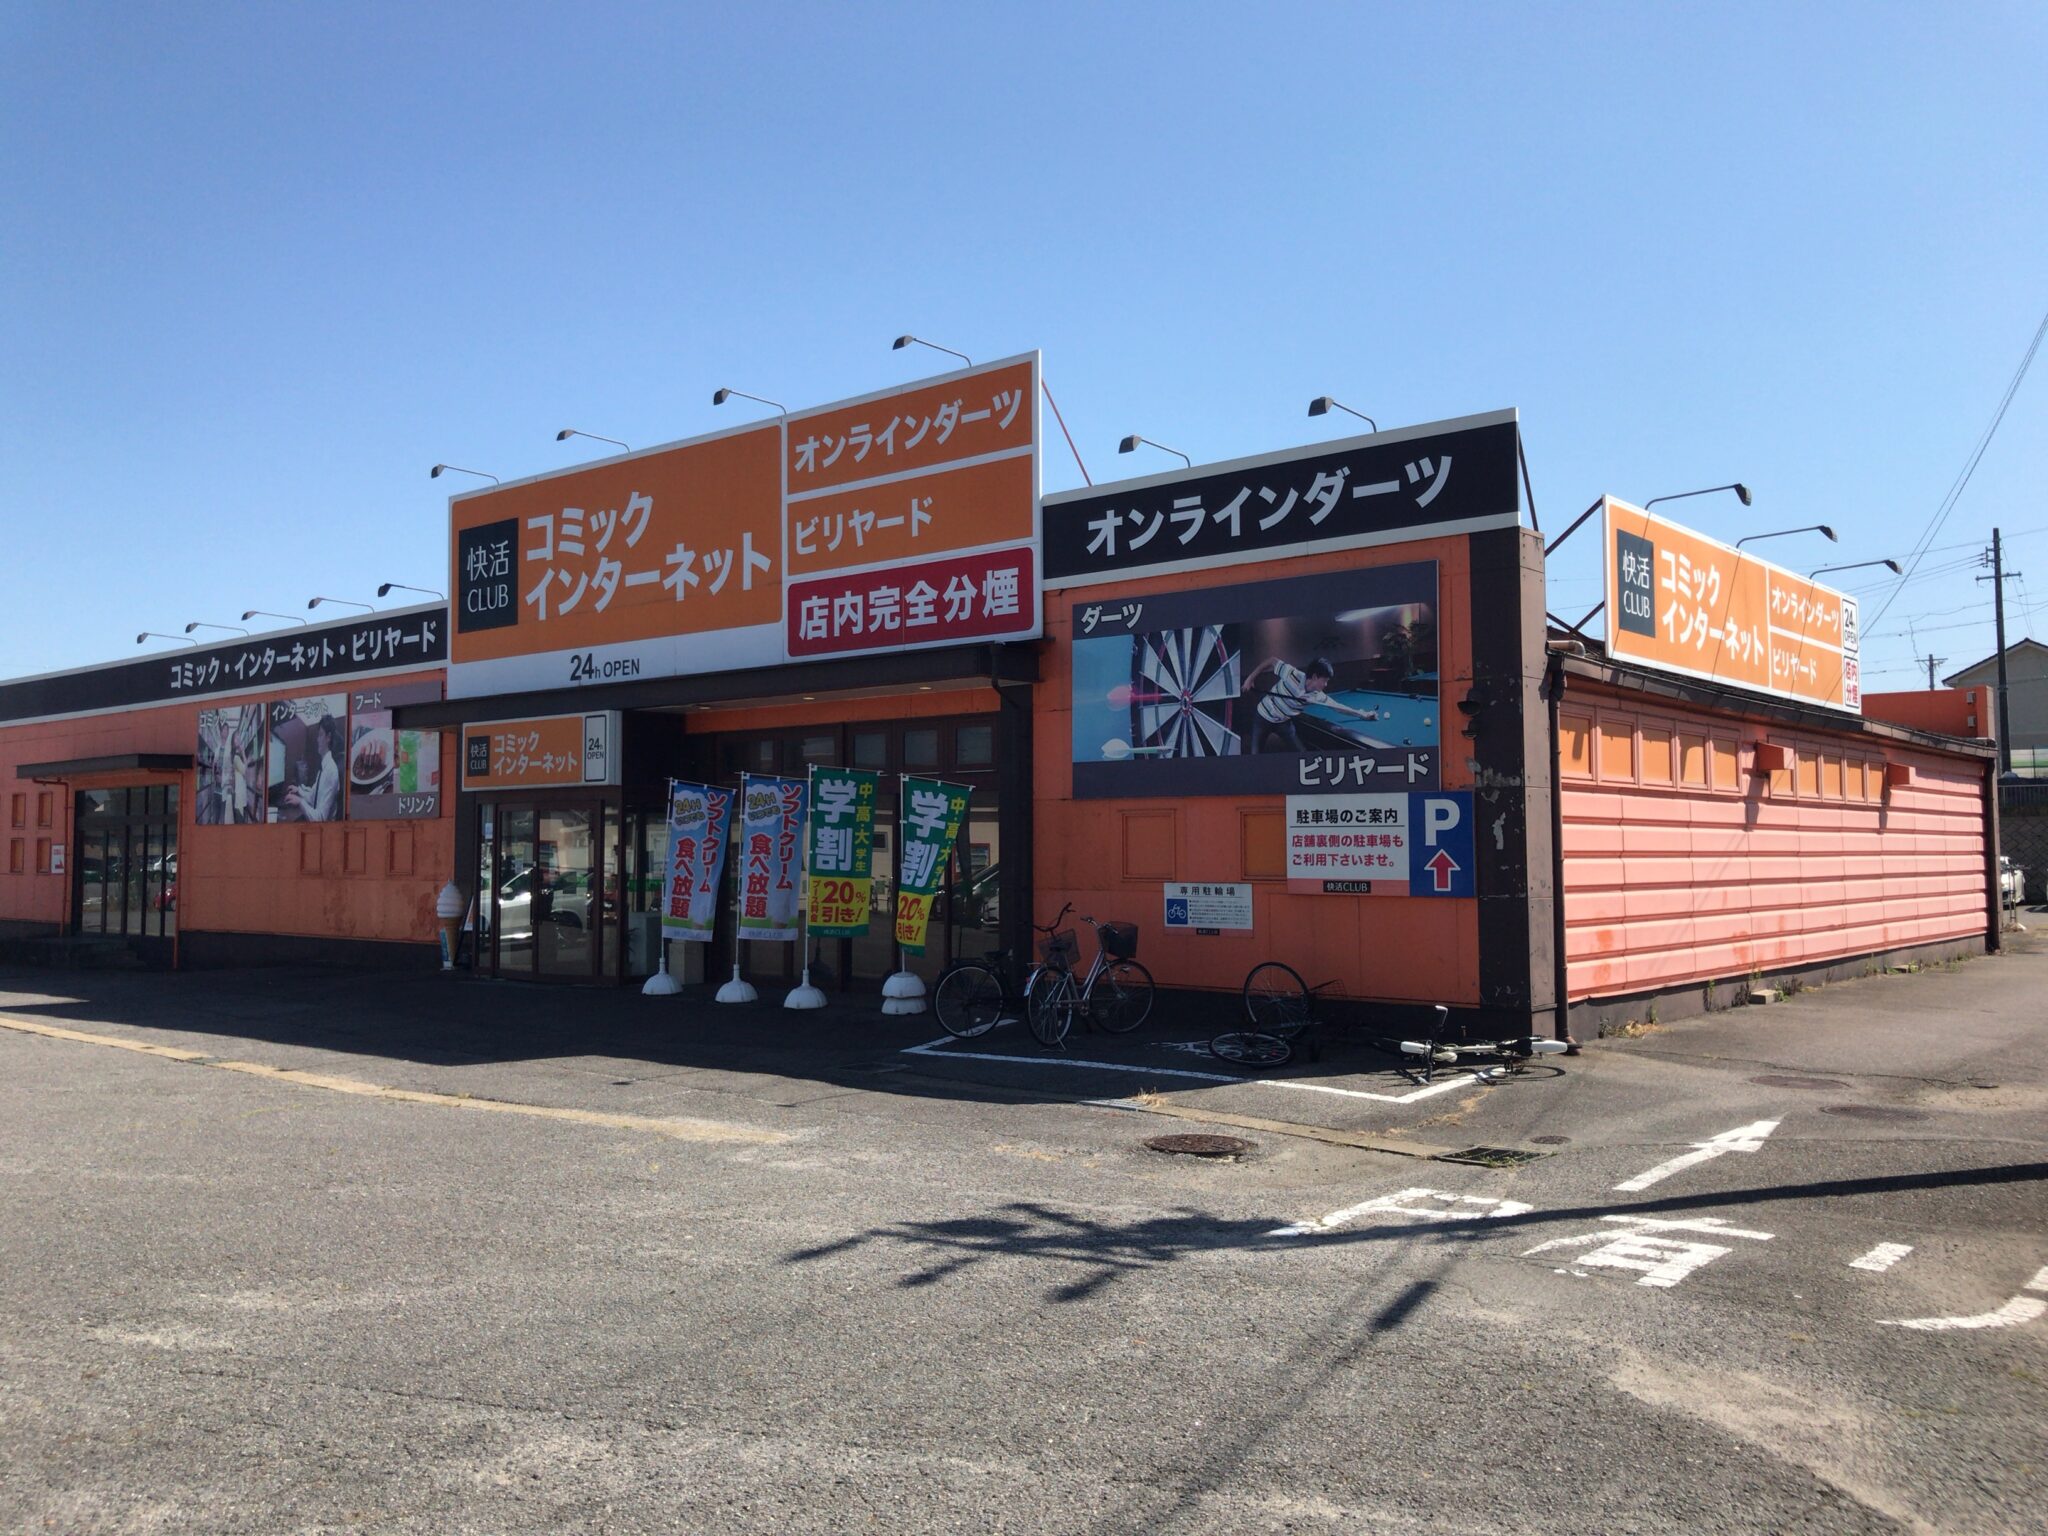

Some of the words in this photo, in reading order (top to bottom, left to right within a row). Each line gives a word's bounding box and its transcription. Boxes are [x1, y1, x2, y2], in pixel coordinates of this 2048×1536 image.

[794, 388, 1023, 473] オンラインダーツ
[1086, 455, 1453, 557] オンラインダーツ
[526, 491, 654, 561] コミック
[796, 496, 932, 555] ビリヤード
[467, 540, 509, 582] 快活
[525, 532, 771, 621] インターネット
[1622, 549, 1650, 589] 快活
[1660, 549, 1721, 607] コミック
[467, 584, 509, 613] CLUB
[799, 567, 1020, 640] 店内完全分煙
[1623, 590, 1651, 618] CLUB
[1772, 586, 1839, 633] オンラインダーツ
[1080, 603, 1143, 634] ダーツ
[1661, 600, 1764, 665] インターネット
[171, 620, 437, 689] コミック・インターネット・ビリヤード
[603, 658, 640, 678] OPEN
[1773, 648, 1817, 685] ビリヤード
[272, 698, 328, 720] インターネット
[356, 692, 382, 710] フード
[470, 743, 487, 757] 快活
[494, 730, 540, 753] コミック
[587, 751, 604, 760] OPEN
[470, 759, 487, 770] CLUB
[494, 751, 578, 775] インターネット
[1299, 752, 1430, 786] ビリヤード
[398, 795, 435, 814] ドリンク
[747, 791, 776, 809] 24H
[1296, 808, 1398, 824] 駐車場のご案内
[776, 784, 802, 890] ソフトクリーム
[815, 779, 857, 871] 学割
[901, 790, 949, 887] 学割
[1292, 834, 1404, 848] 店舗裏側の駐車場も
[1424, 799, 1461, 846] P
[699, 792, 728, 893] ソフトクリーム
[1292, 853, 1394, 867] ご利用下さいませ。
[669, 836, 697, 918] 食べ放題
[745, 833, 774, 918] 食べ放題
[820, 881, 866, 904] 20%
[898, 895, 925, 921] 20%
